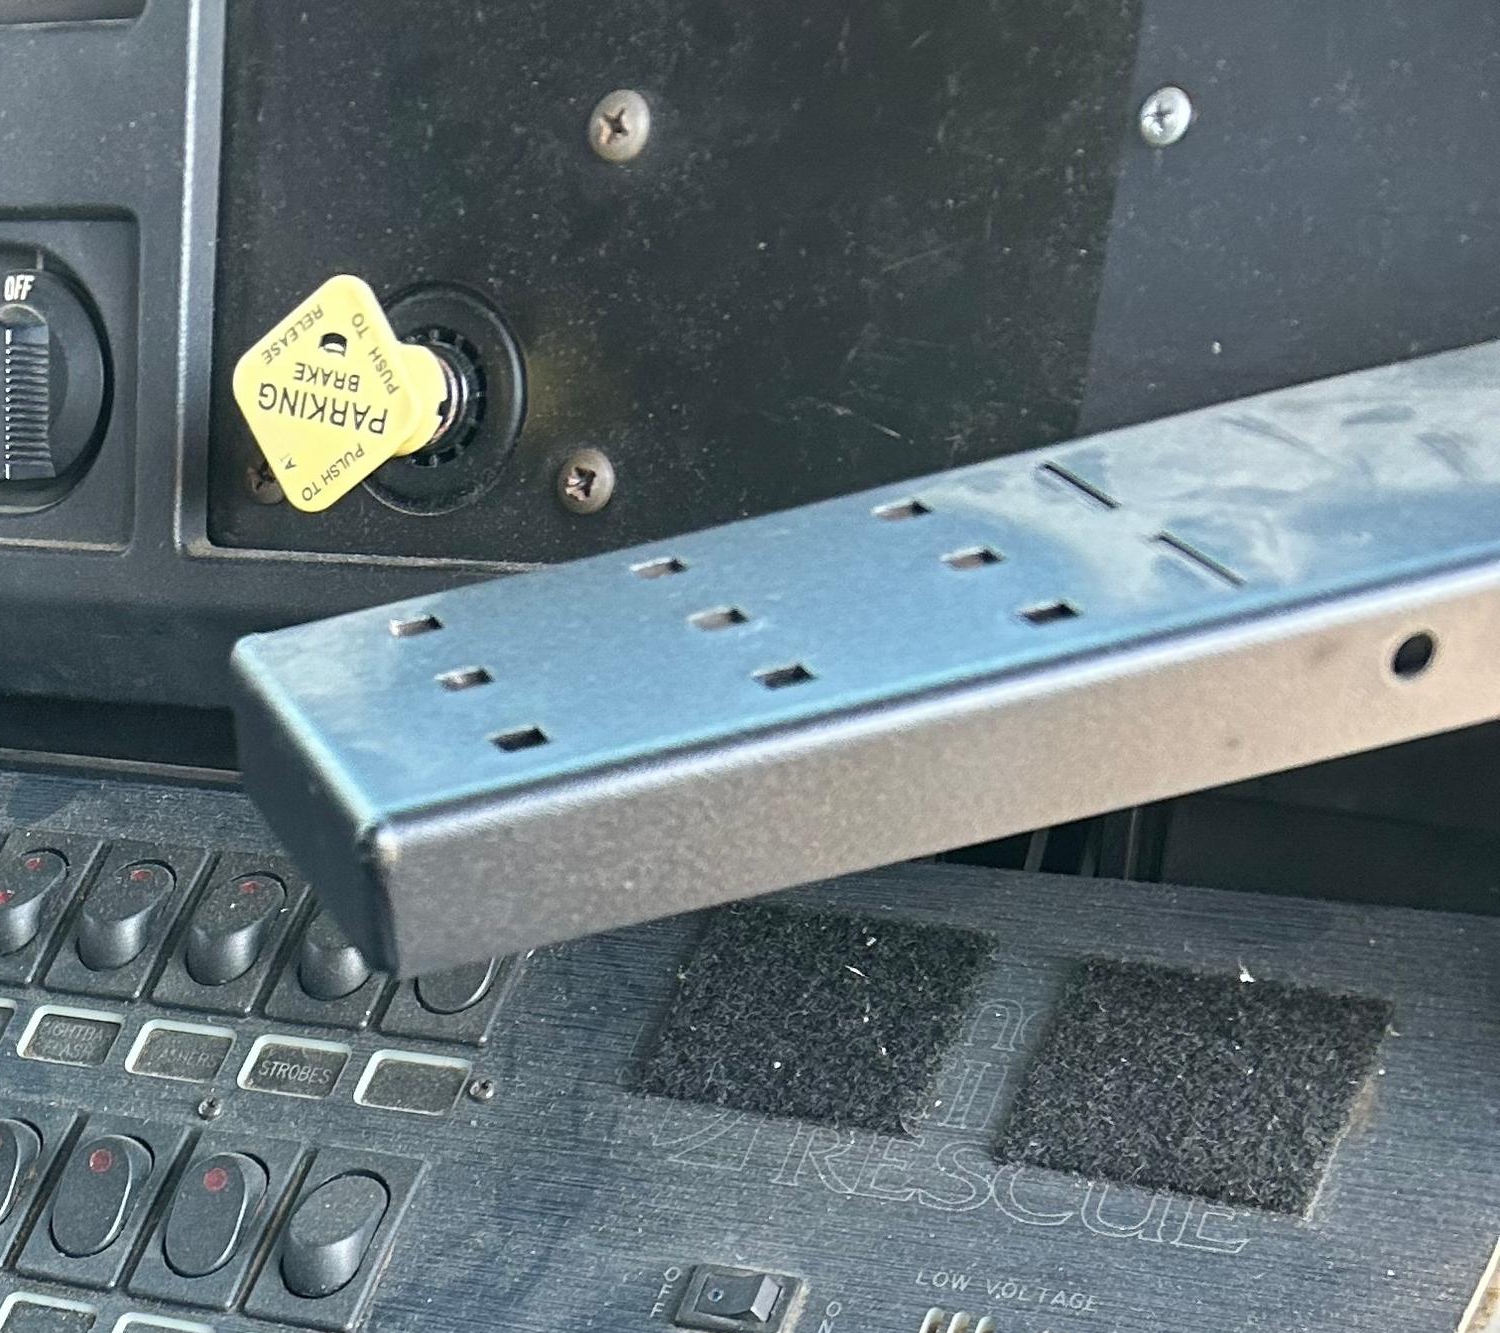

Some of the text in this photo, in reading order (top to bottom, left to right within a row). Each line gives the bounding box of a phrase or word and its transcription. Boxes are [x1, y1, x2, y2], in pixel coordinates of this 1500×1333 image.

[3, 275, 35, 301] OFF
[261, 304, 325, 365] RELEASE
[351, 311, 399, 395] PUSH TO
[293, 362, 360, 392] BRAKE
[258, 382, 388, 434] PARKING
[301, 483, 322, 501] TO
[258, 1060, 332, 1084] STROBES
[915, 1271, 1100, 1313] LOW VOLTAGE
